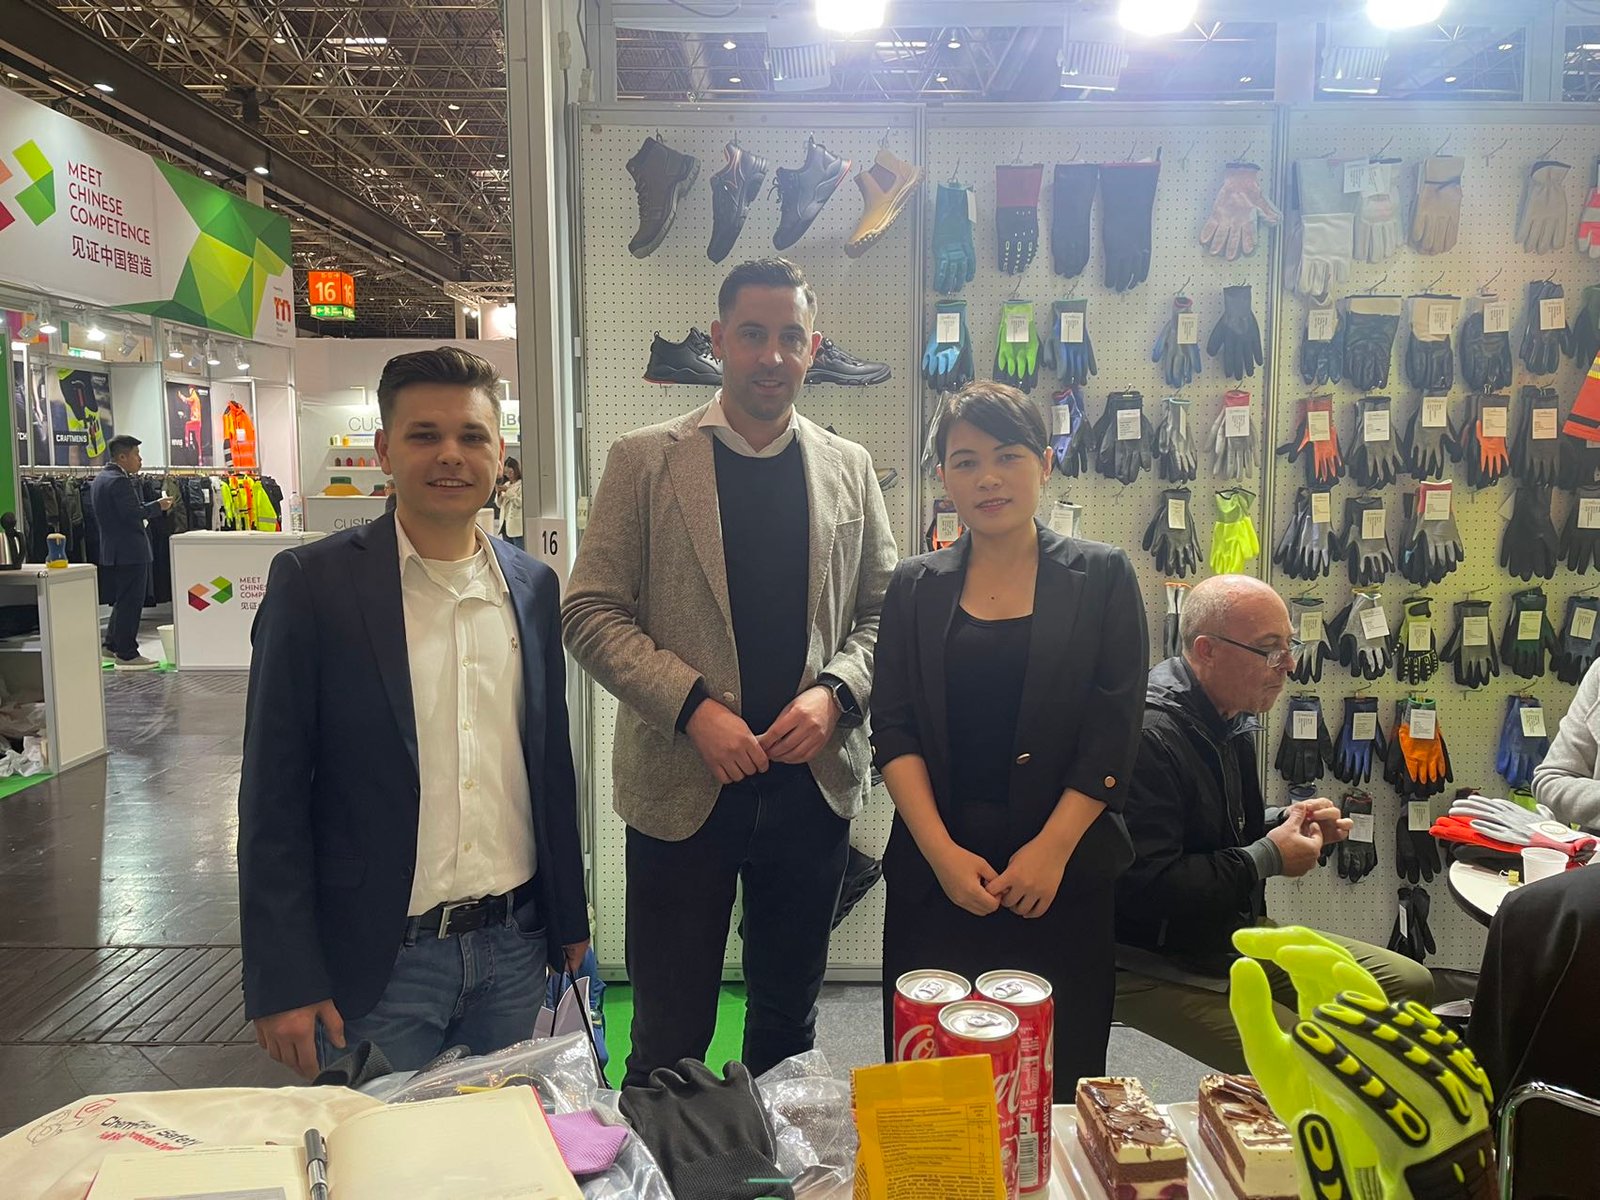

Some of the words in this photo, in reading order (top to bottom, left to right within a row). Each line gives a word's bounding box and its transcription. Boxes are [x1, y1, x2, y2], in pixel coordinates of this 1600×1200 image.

[68, 160, 102, 187] MEET
[69, 182, 122, 216] CHINESE
[70, 205, 151, 245] COMPETENCE
[72, 235, 153, 278] 见证中国智造
[315, 281, 336, 302] 16
[344, 283, 353, 305] 16
[542, 530, 558, 556] 16
[241, 602, 260, 610] 见证
